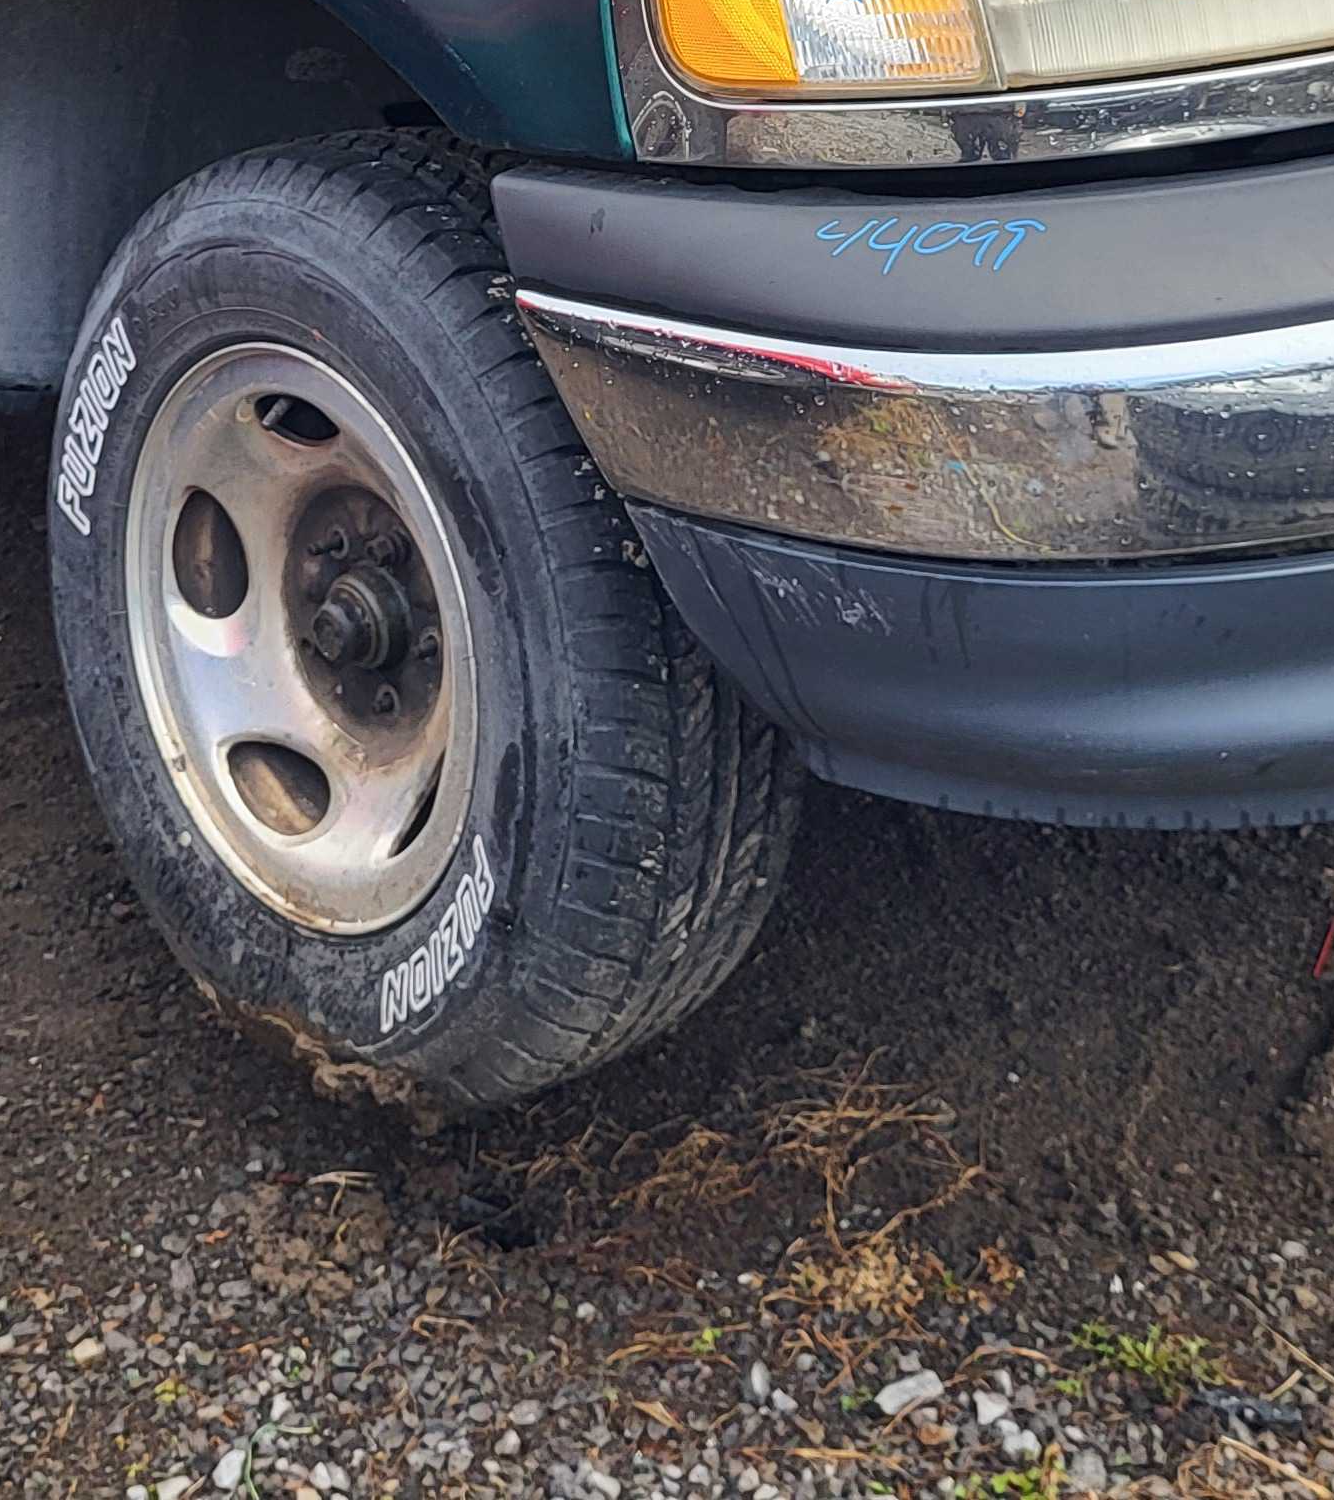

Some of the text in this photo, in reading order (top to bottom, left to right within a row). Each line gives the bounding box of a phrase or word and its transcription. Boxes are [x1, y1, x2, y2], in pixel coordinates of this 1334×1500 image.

[816, 217, 1047, 276] 44099
[57, 316, 137, 536] FUZION
[380, 833, 495, 1034] FUZION
